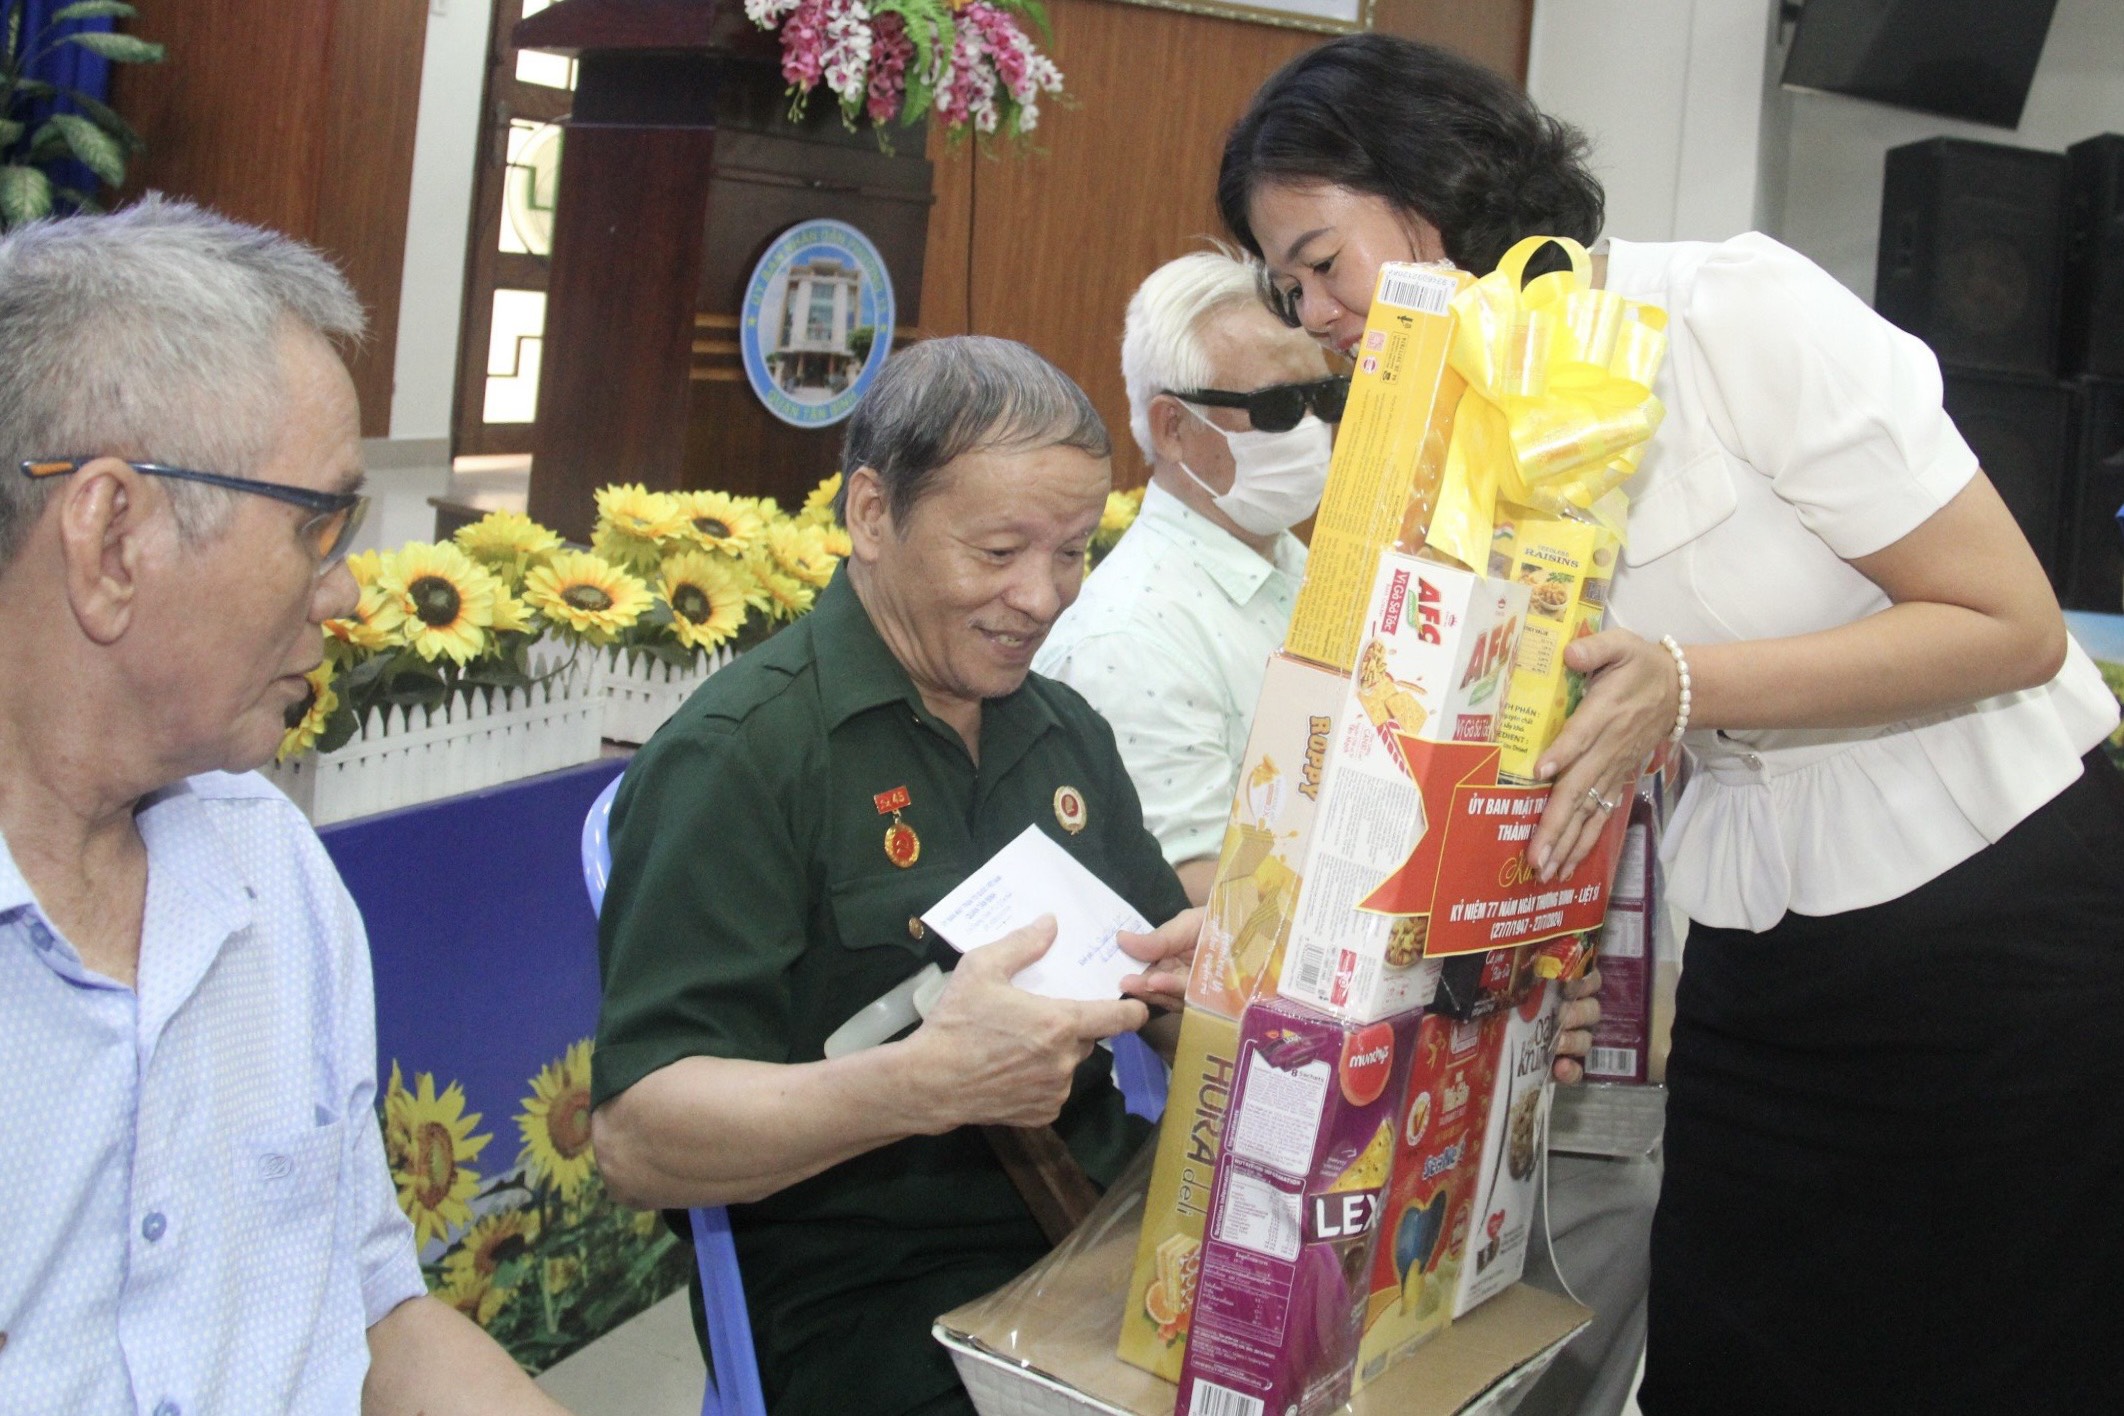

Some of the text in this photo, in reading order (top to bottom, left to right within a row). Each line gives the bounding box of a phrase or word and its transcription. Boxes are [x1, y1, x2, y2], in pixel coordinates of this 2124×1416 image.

[1525, 547, 1579, 568] RAISINS
[1418, 576, 1440, 645] AFC
[1459, 615, 1517, 691] AFC
[1468, 792, 1485, 815] ỦY
[1485, 798, 1510, 815] BAN
[1511, 796, 1534, 819] MẶT
[1498, 821, 1531, 841] THÀNH
[1450, 898, 1464, 922] KỶ
[1464, 899, 1487, 924] NIỆM
[1487, 901, 1499, 918] 77
[1498, 897, 1519, 917] NĂM
[1517, 893, 1537, 914] NGÀY
[1578, 884, 1594, 905] LIỆT
[1291, 1068, 1298, 1077] 8
[1177, 1054, 1234, 1216] HURA deli
